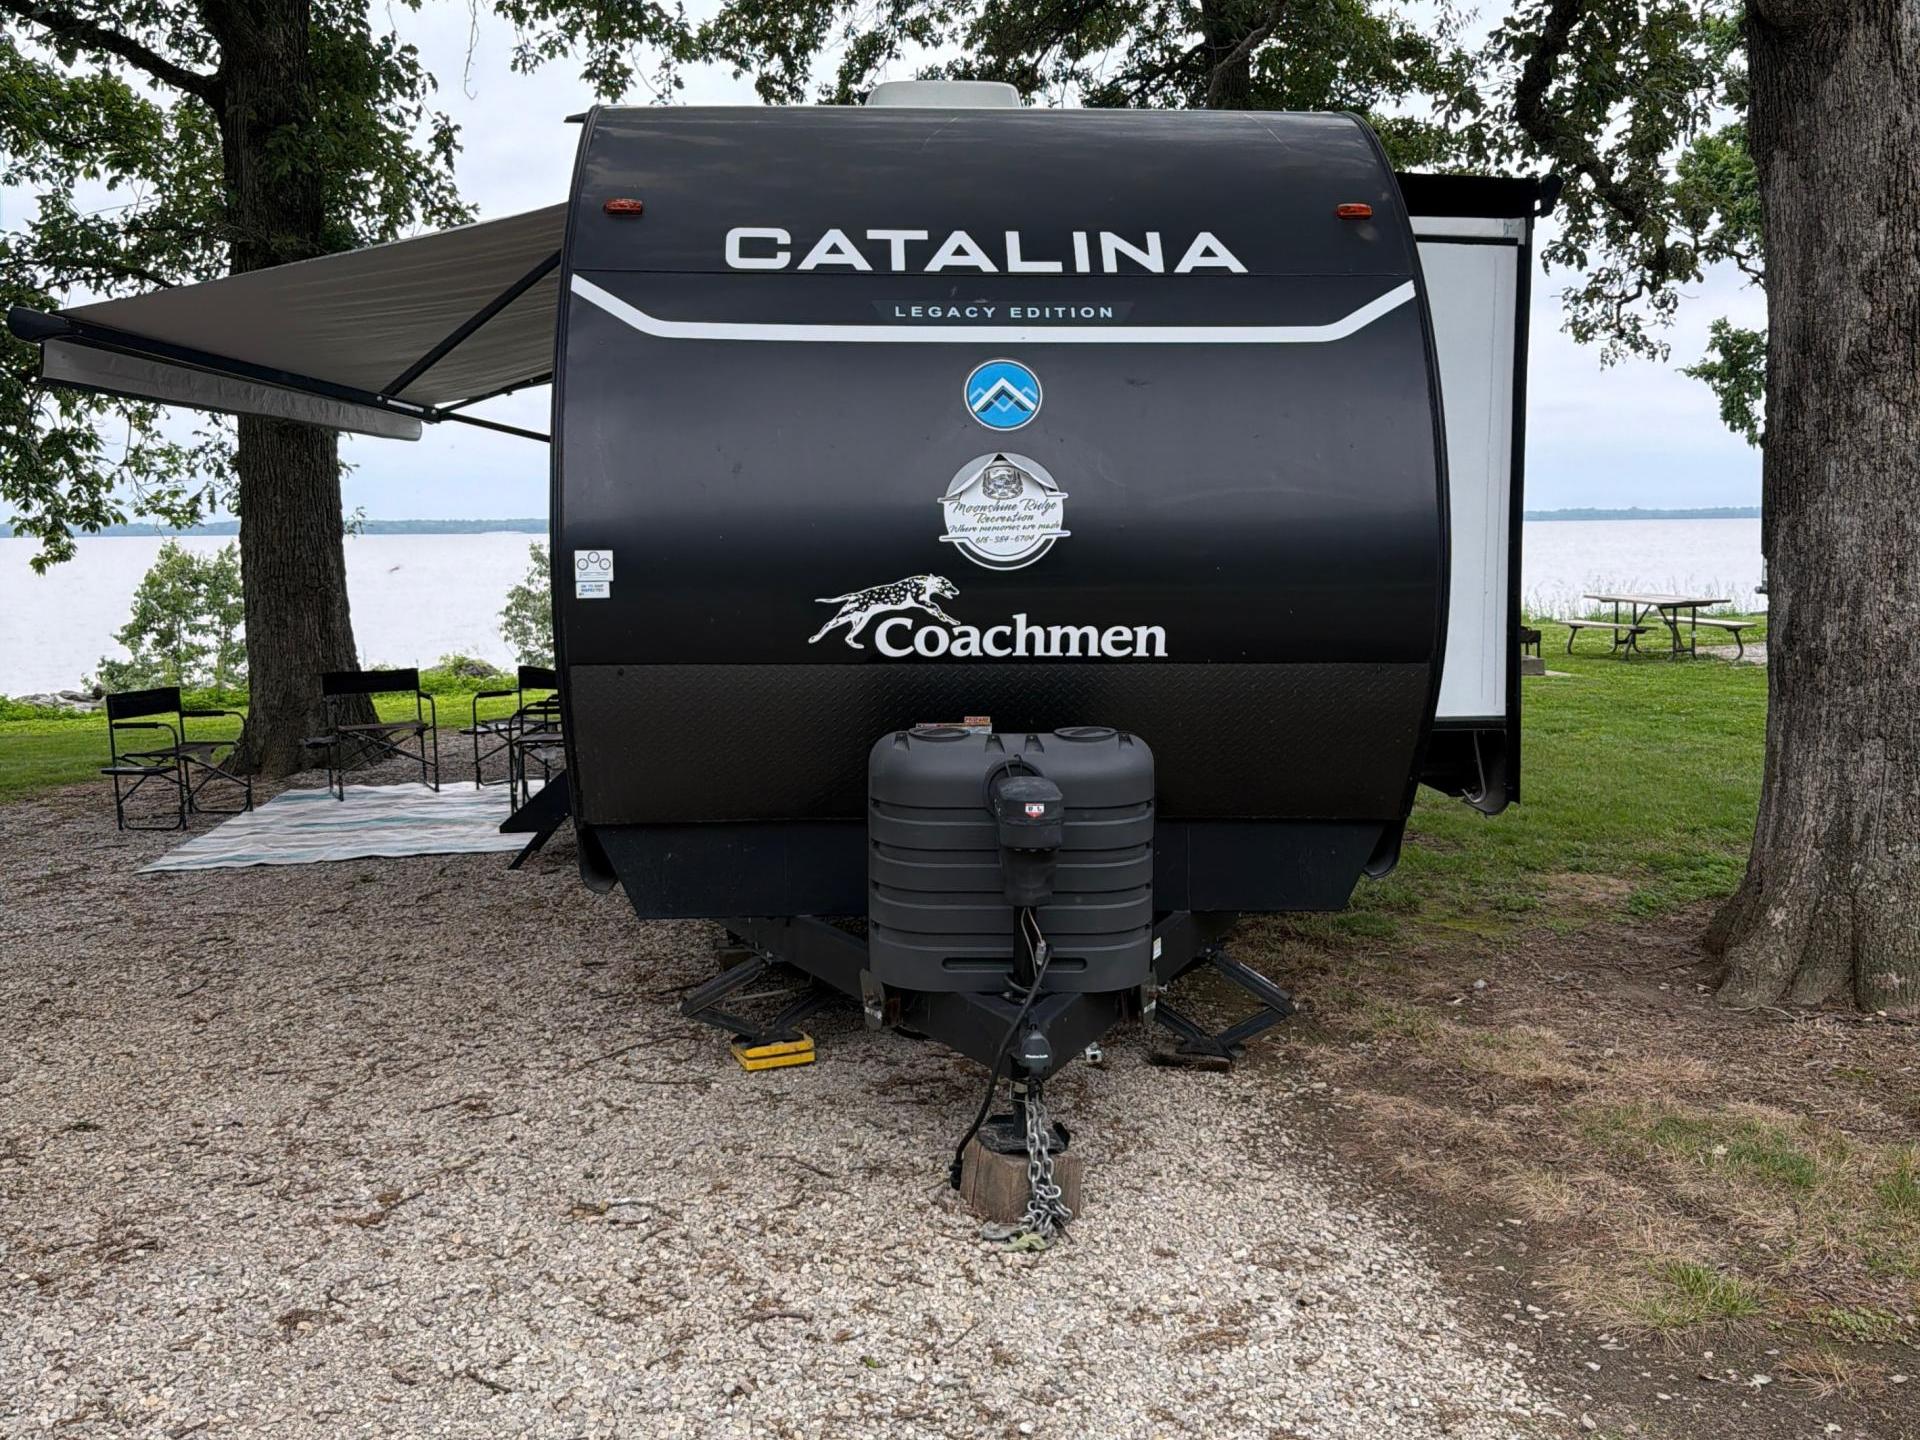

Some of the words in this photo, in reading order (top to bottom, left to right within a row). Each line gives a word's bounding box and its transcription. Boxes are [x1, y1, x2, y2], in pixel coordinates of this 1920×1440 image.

[725, 227, 1249, 273] CATALINA
[895, 306, 996, 318] LEGACY
[1010, 307, 1113, 318] EDITION
[949, 499, 1018, 515] Moonshine
[1020, 498, 1057, 516] Ridge
[973, 512, 1034, 524] Recreation
[949, 524, 977, 533] Where
[979, 525, 1020, 533] memories
[1037, 521, 1060, 530] made
[874, 613, 1168, 657] Coachmen
